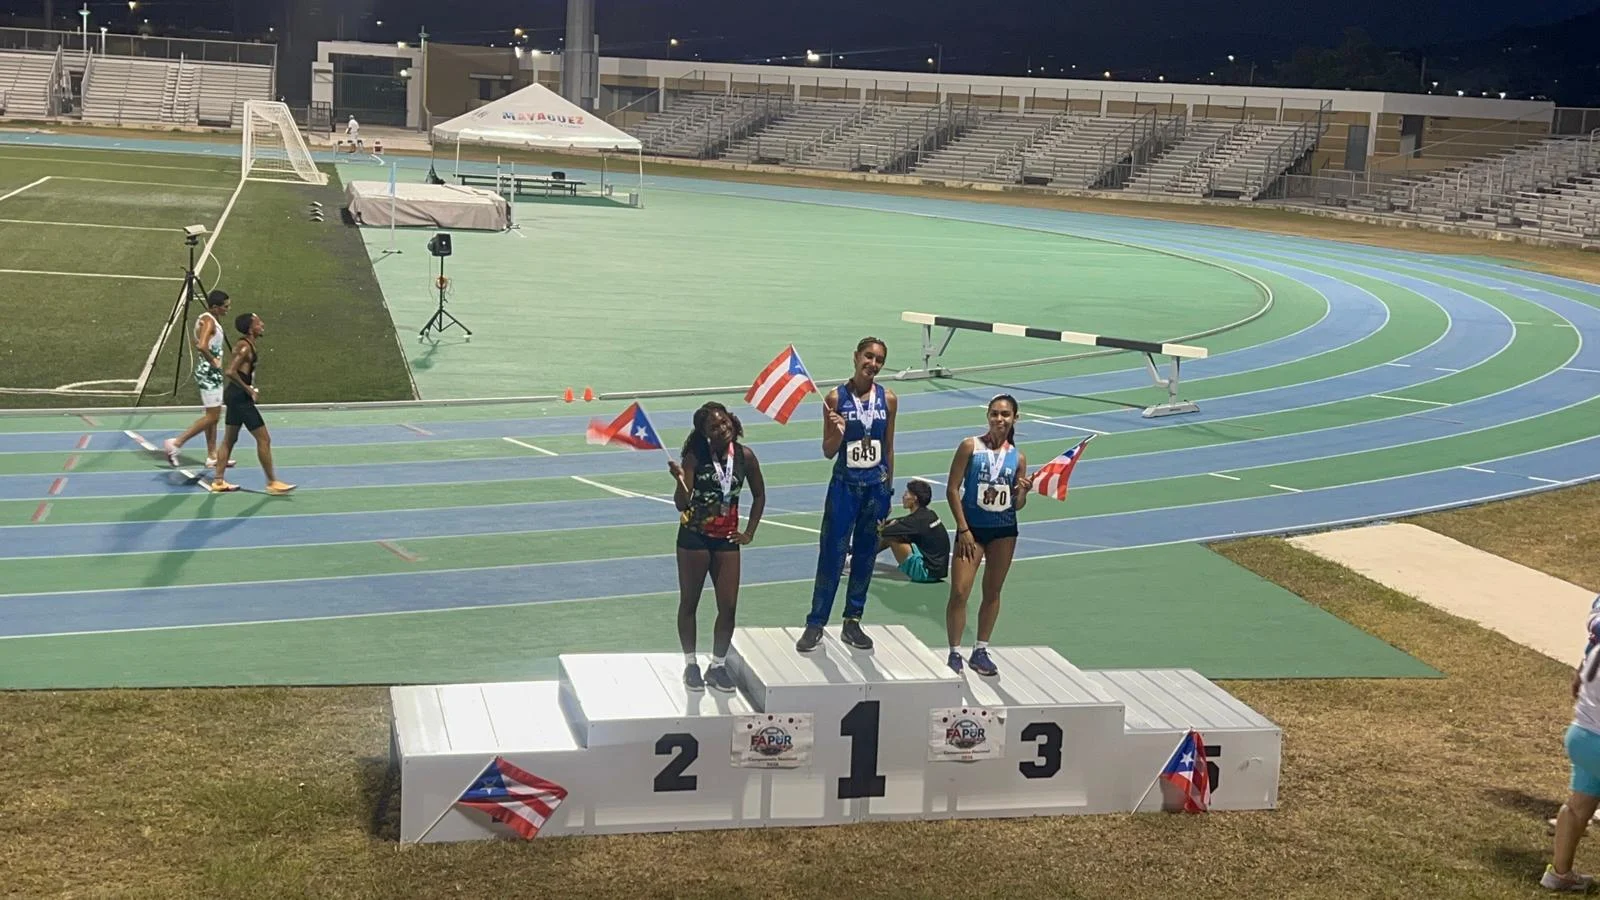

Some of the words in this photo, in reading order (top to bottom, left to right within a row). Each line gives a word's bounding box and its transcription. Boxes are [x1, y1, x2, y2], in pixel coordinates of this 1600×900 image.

[852, 446, 876, 462] 649
[750, 735, 792, 746] FAPUR
[838, 700, 886, 799] 1
[946, 728, 985, 739] FAPUR
[1019, 722, 1063, 779] 3
[653, 733, 699, 792] 2
